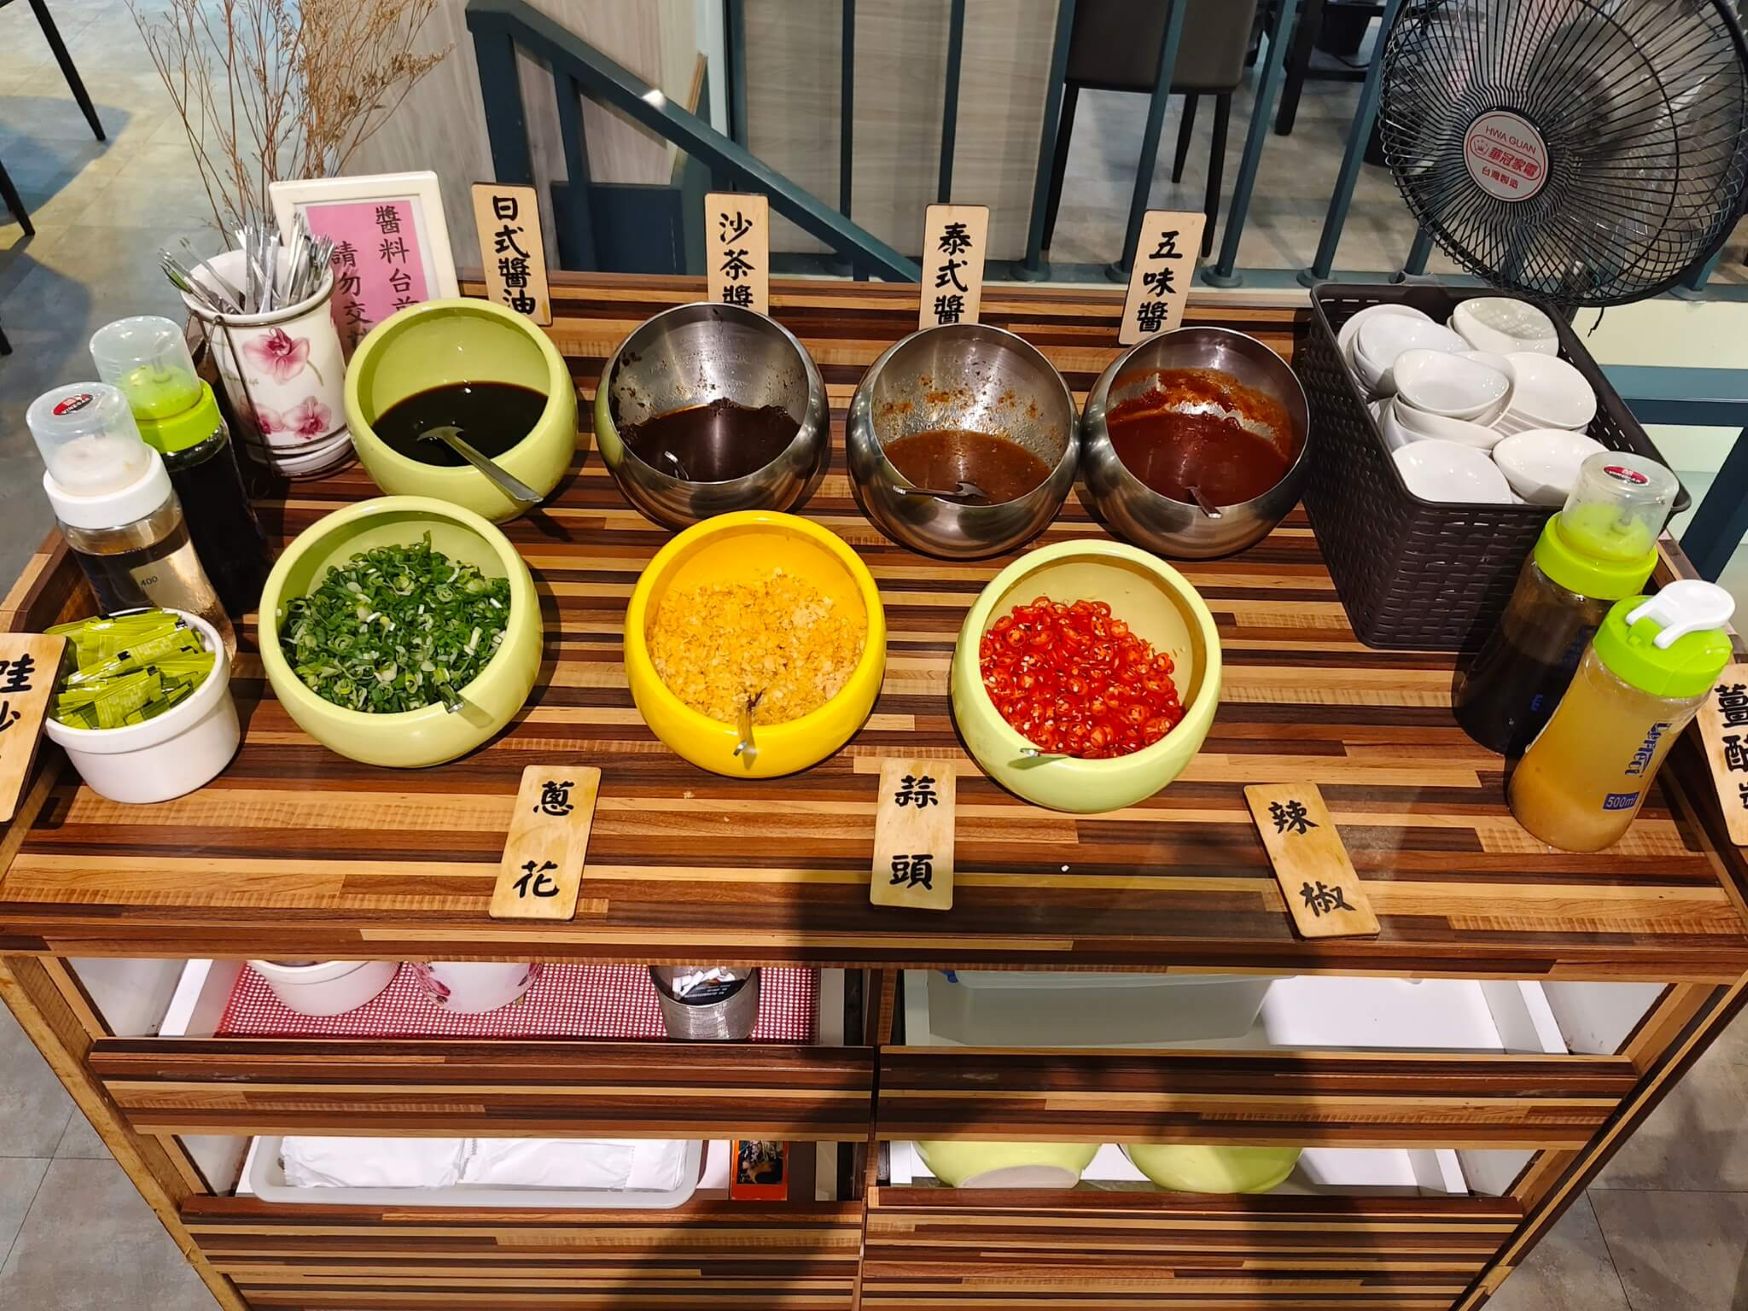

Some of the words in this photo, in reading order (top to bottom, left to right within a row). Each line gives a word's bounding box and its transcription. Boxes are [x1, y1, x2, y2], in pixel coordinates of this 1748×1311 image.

[1482, 166, 1519, 189] 台灣製造
[1485, 126, 1507, 143] HWA
[1508, 136, 1537, 155] GUAN
[1488, 147, 1539, 177] 華冠家電
[492, 195, 536, 315] 日式醬油
[719, 211, 756, 307] 沙茶醬
[934, 222, 973, 325] 泰式醬
[1137, 230, 1183, 333] 五味醬
[141, 575, 158, 586] 400
[512, 780, 576, 898] 蔥花
[889, 775, 938, 890] 蒜頭
[1268, 800, 1357, 917] 辣椒
